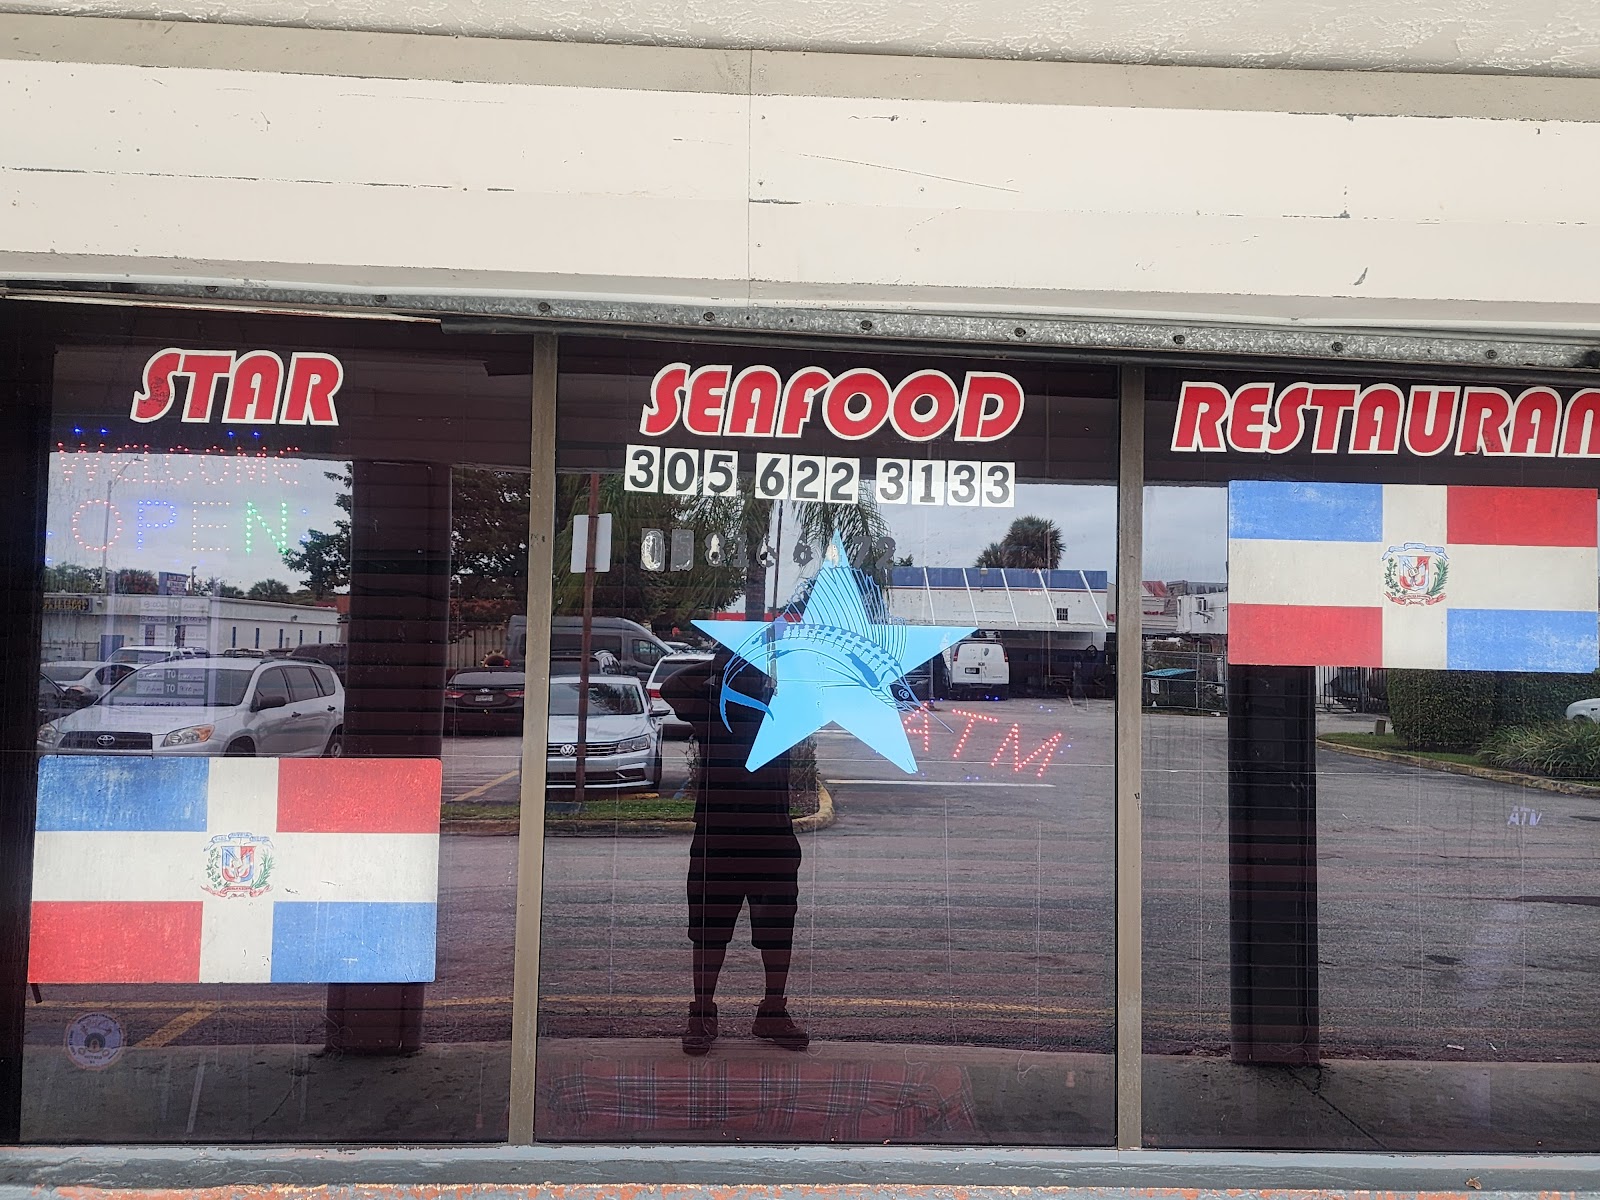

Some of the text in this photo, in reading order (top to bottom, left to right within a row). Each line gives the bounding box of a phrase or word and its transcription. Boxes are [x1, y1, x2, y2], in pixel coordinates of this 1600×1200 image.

[130, 347, 1600, 457] STAR SEAFOOD RESTAURAN
[57, 441, 300, 485] WELCOME
[628, 448, 1010, 504] 305 622 3133
[71, 498, 288, 553] OPEN
[165, 683, 176, 693] TO
[166, 670, 176, 679] TO
[902, 701, 1065, 778] ATM
